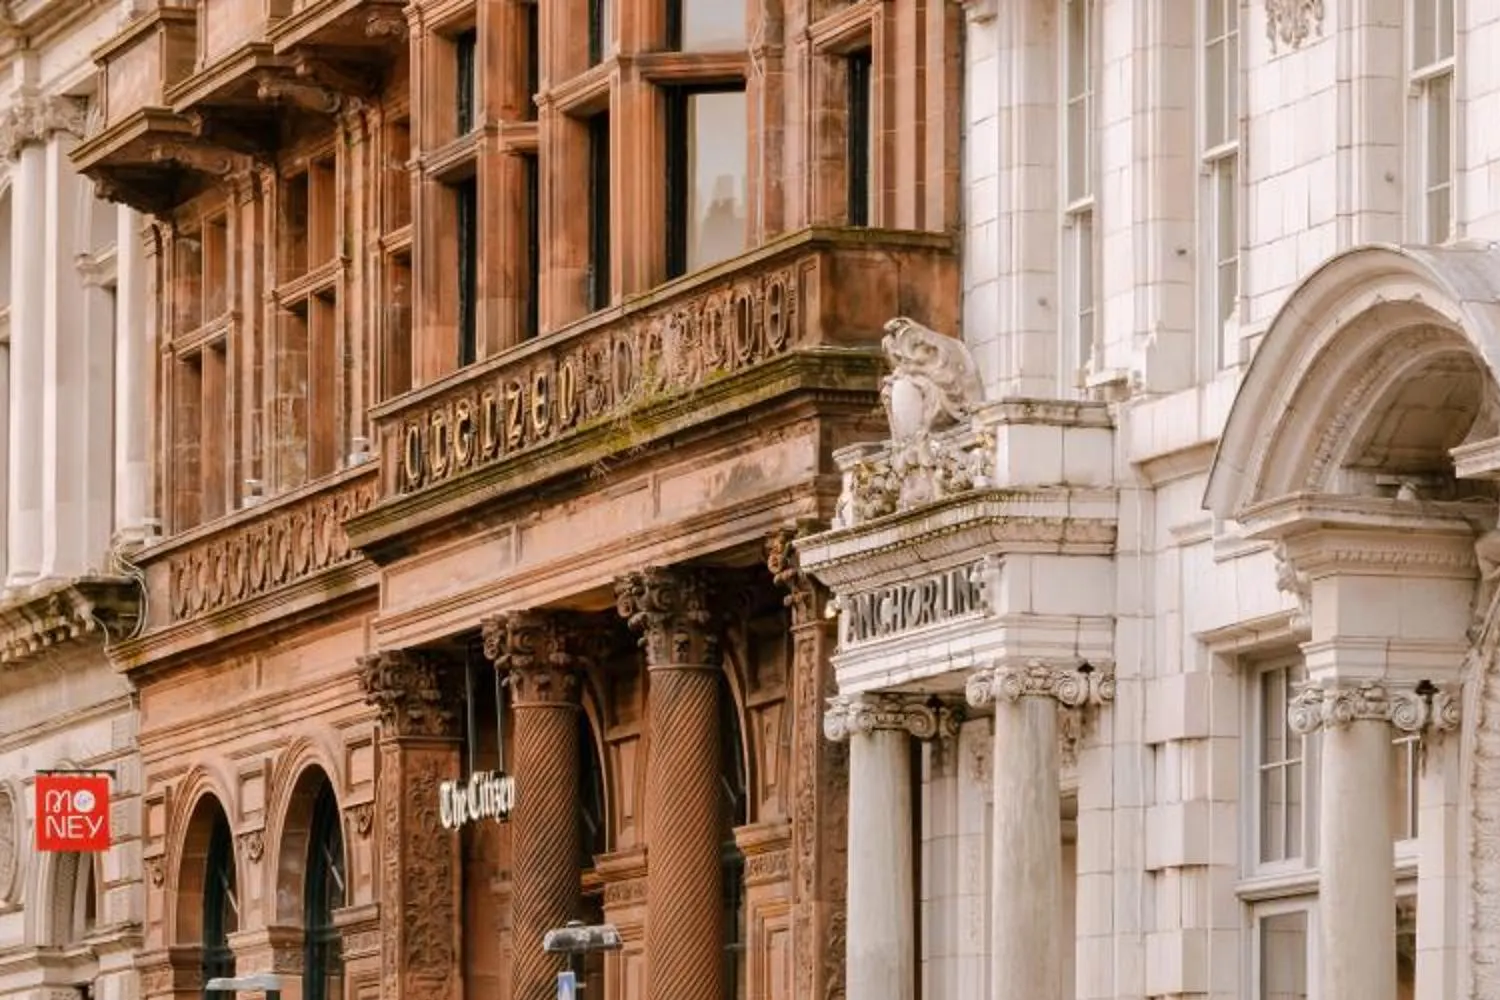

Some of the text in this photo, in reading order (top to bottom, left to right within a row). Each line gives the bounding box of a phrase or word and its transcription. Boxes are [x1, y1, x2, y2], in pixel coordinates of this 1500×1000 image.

[847, 564, 989, 643] ANCHOR LINE
[45, 815, 104, 838] NEY
[440, 770, 515, 830] The Citizen
